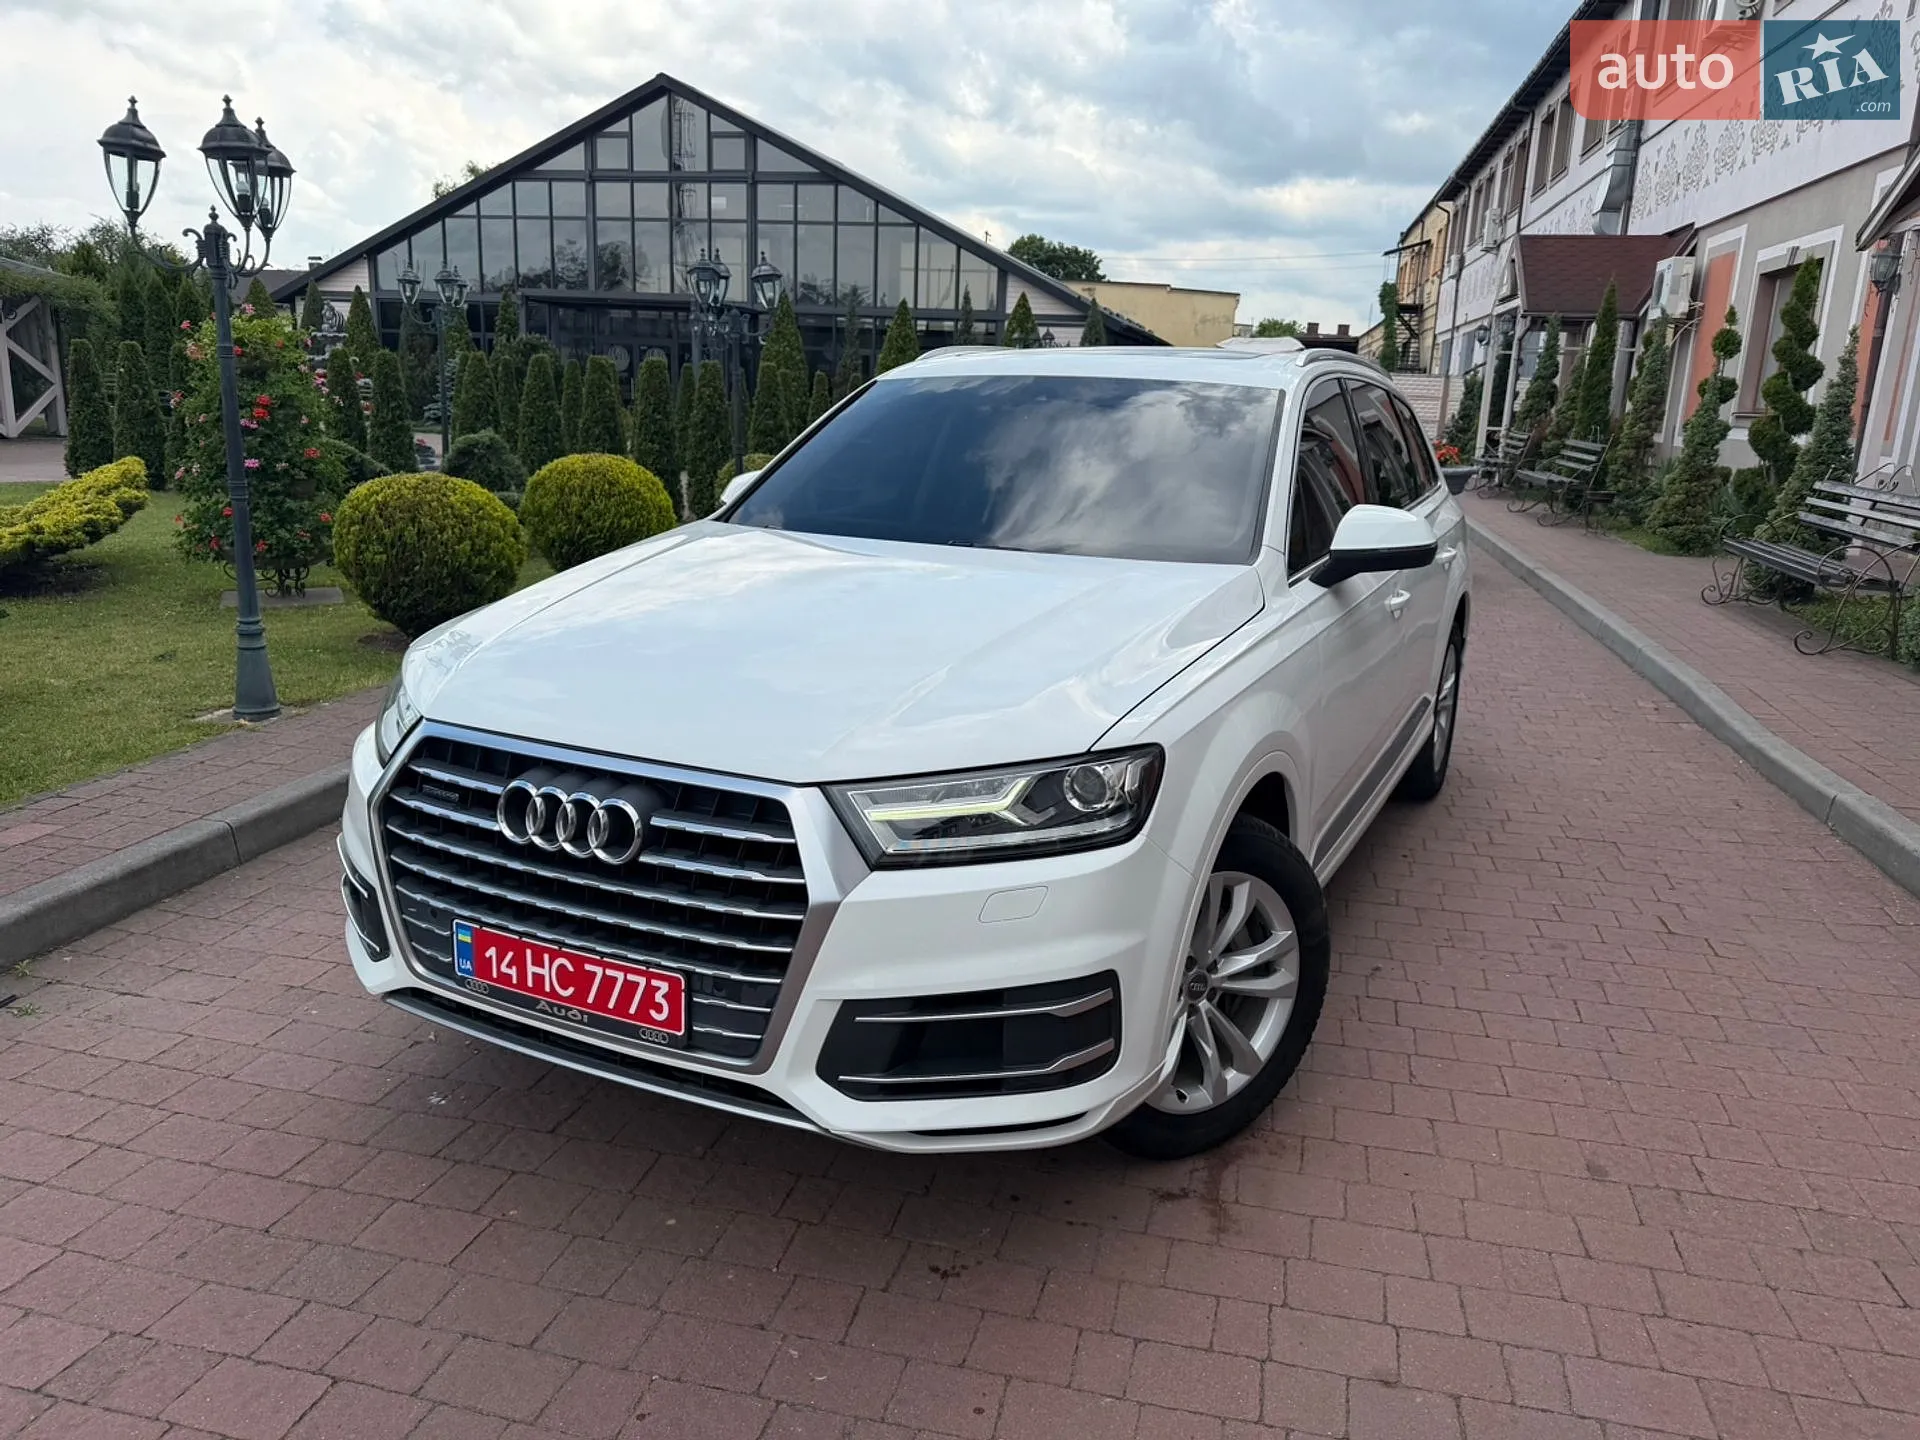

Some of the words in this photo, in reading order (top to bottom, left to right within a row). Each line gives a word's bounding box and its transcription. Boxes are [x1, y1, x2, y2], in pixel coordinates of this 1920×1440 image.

[458, 956, 473, 972] UA
[484, 946, 518, 985] 14
[525, 948, 575, 998] HC
[583, 963, 669, 1022] 7773
[535, 1000, 589, 1024] Audi
